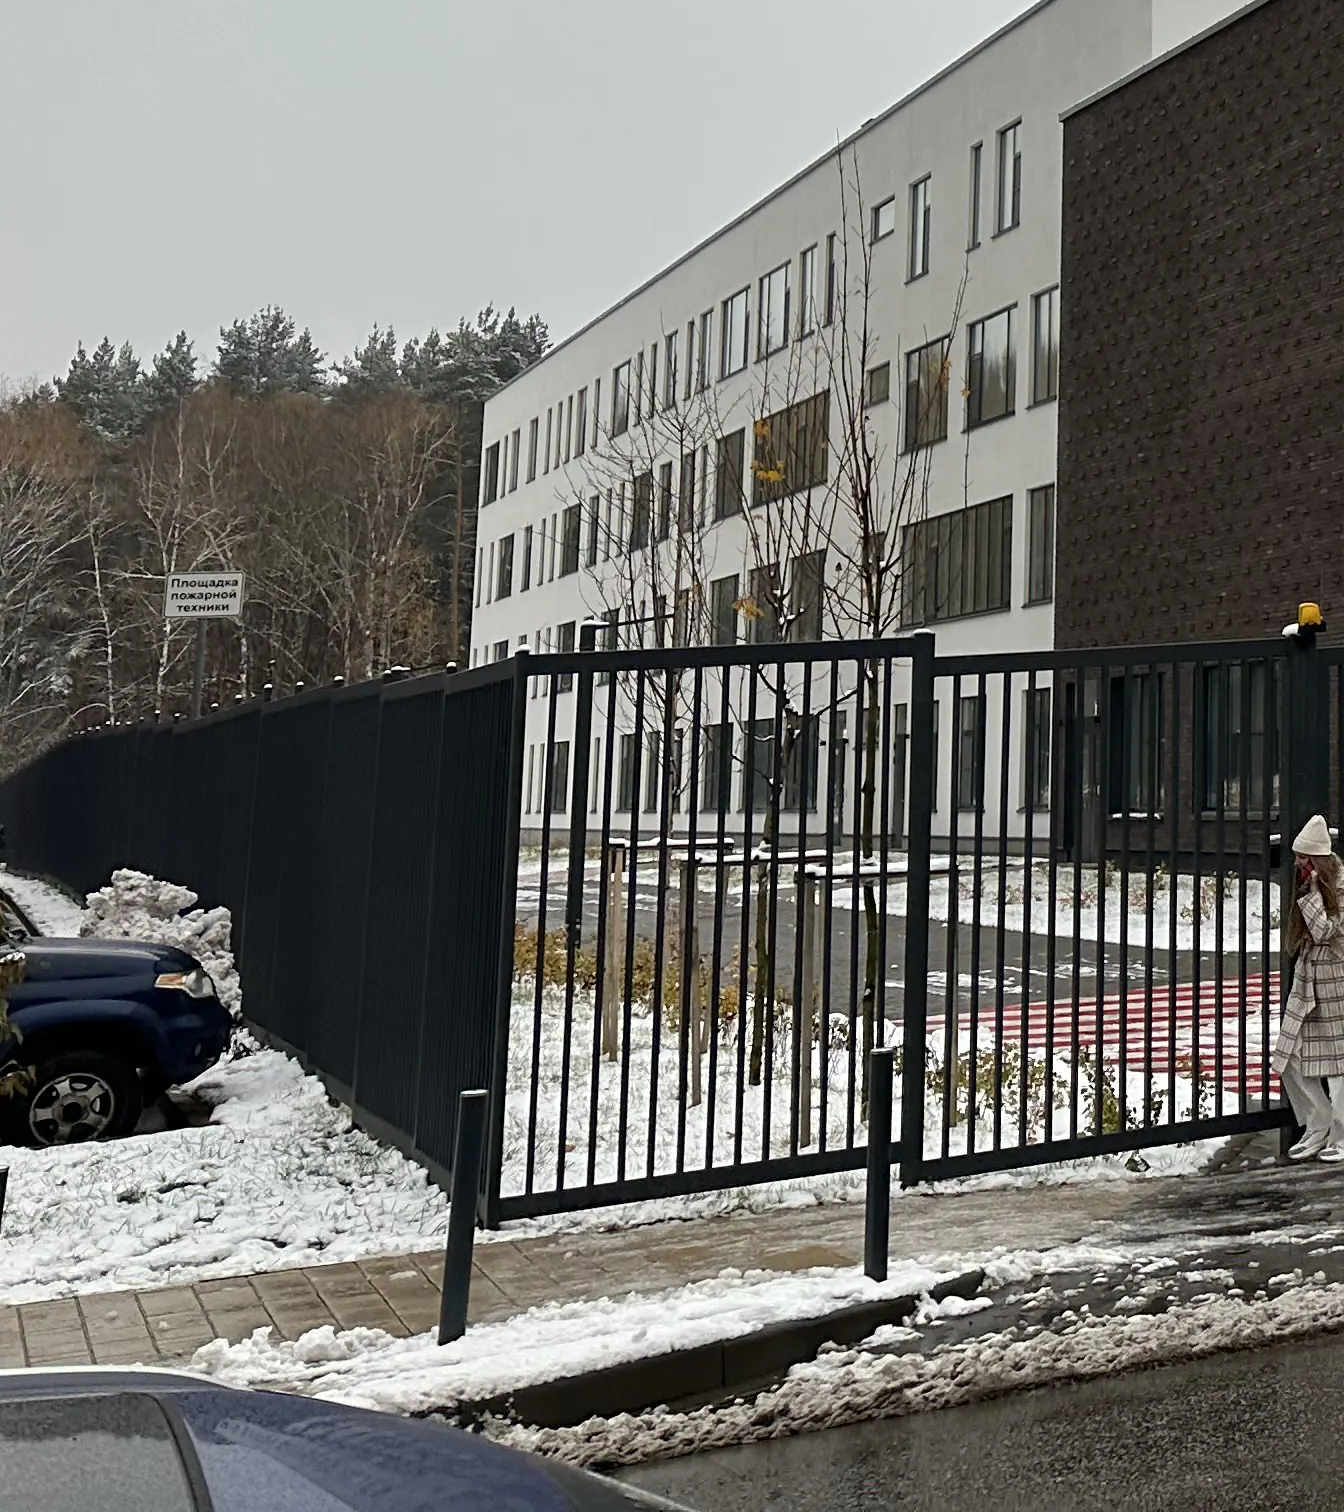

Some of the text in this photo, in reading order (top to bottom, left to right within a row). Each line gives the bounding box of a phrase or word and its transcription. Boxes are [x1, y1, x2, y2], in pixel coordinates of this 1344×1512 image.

[171, 578, 239, 589] Площадка
[170, 589, 237, 601] пожарной
[176, 603, 230, 613] техники
